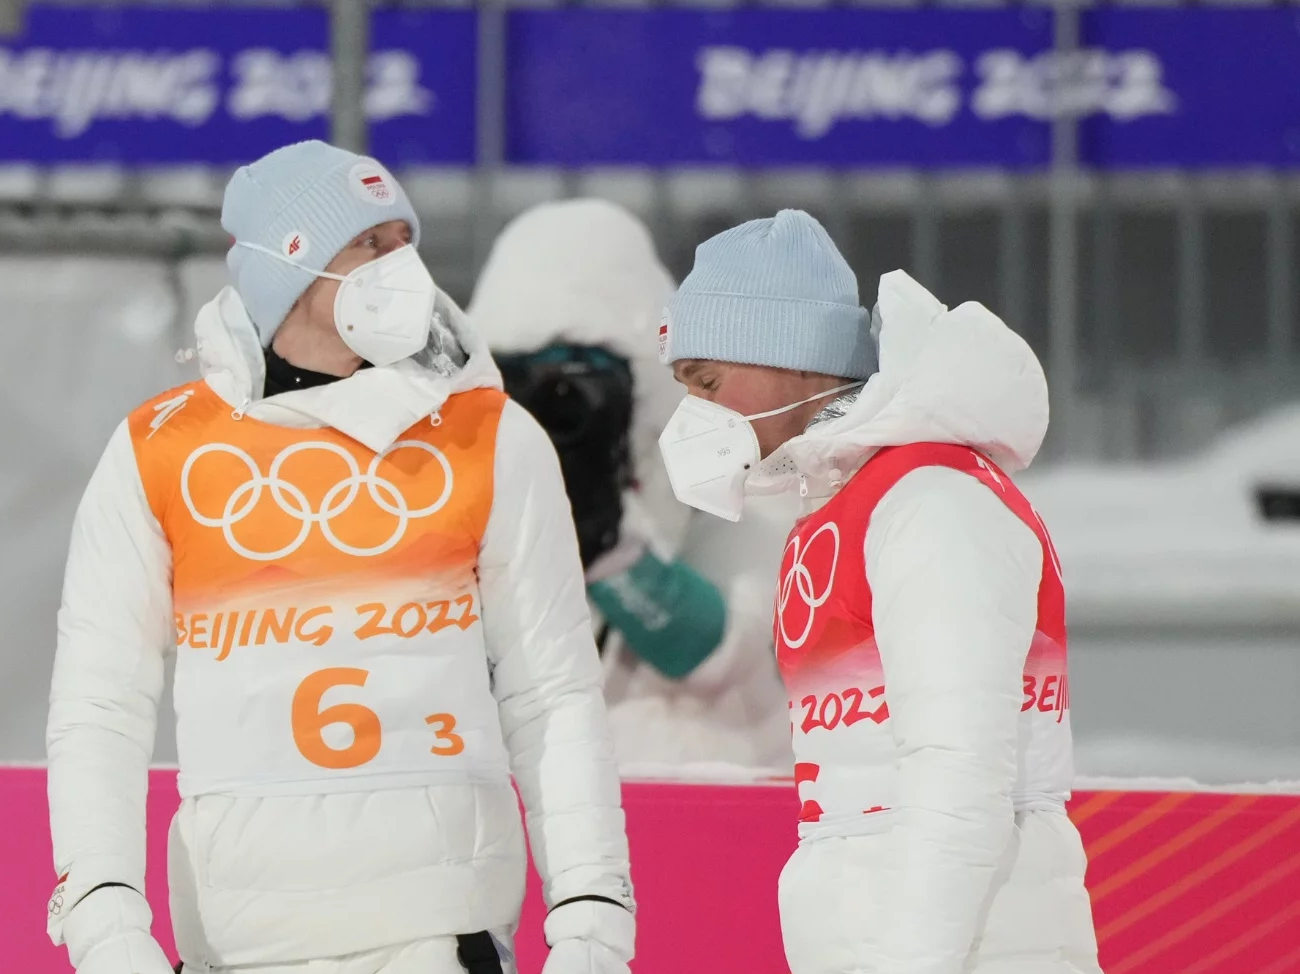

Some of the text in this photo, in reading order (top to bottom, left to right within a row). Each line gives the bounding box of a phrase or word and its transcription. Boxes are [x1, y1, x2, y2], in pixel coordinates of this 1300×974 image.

[226, 48, 433, 121] 202
[697, 46, 962, 138] BEIJING
[289, 235, 300, 256] 4F
[174, 593, 480, 661] BEIJING 2022
[291, 667, 465, 769] 6 3
